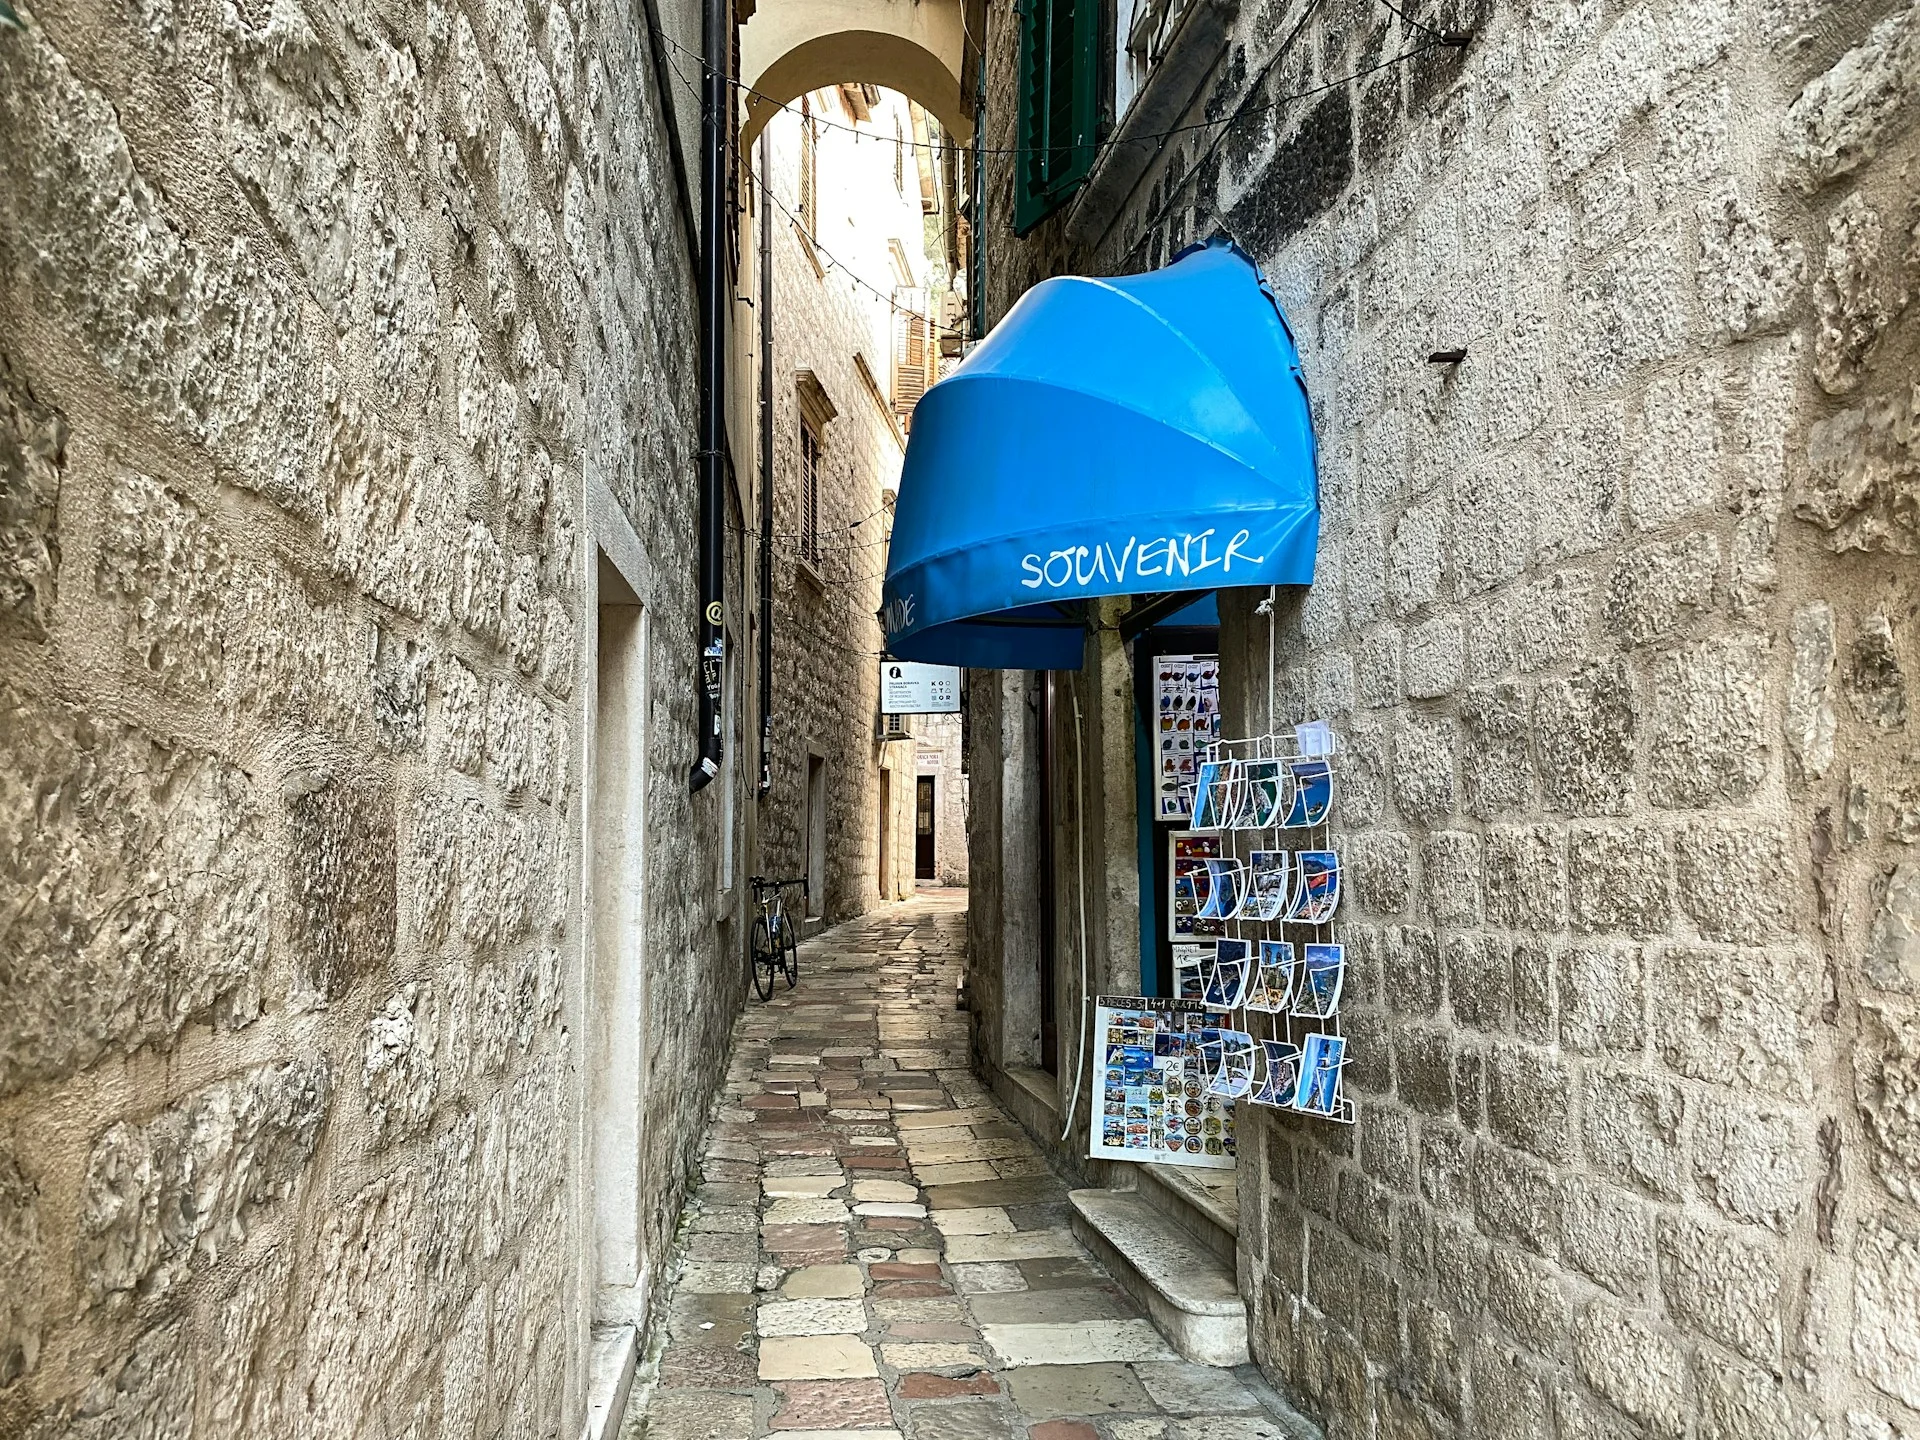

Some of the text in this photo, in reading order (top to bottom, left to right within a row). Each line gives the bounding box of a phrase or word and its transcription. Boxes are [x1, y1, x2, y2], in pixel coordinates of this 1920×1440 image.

[1021, 528, 1264, 588] SOUVENIR
[1172, 945, 1199, 954] MAGNET
[1151, 998, 1204, 1010] 4+1 GRATIS
[1165, 1060, 1180, 1071] 2€
